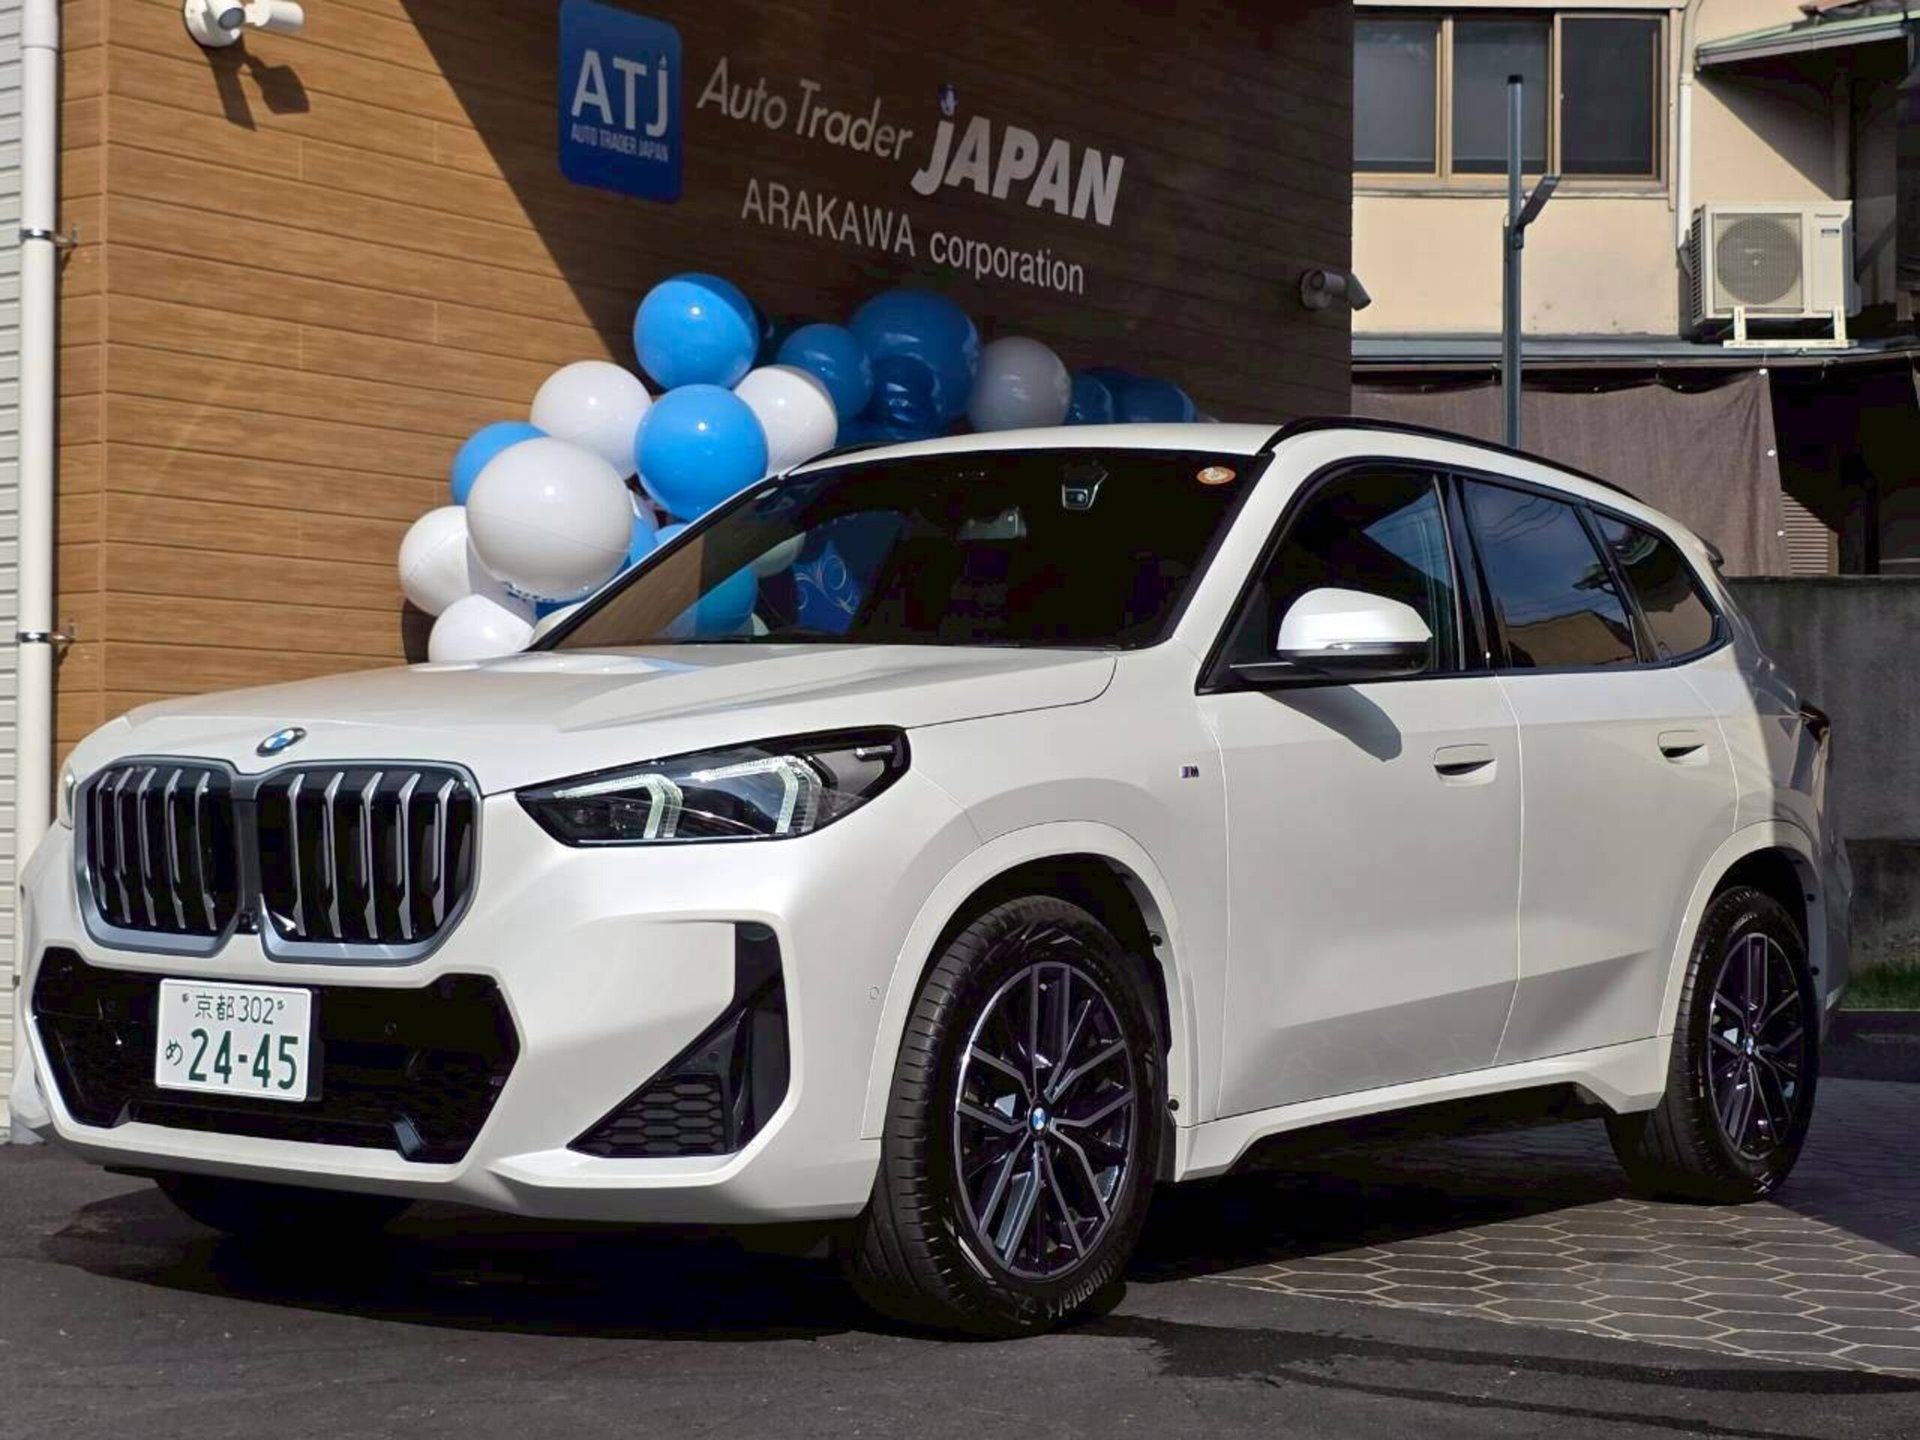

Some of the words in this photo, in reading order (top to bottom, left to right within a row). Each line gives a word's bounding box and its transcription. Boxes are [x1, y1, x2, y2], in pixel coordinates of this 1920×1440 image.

[571, 122, 598, 147] AUTO
[599, 129, 638, 155] TRADER
[638, 140, 669, 163] JAPAN
[696, 56, 788, 130] Auto
[795, 78, 914, 160] Trader
[741, 177, 916, 257] ARAKAWA
[929, 230, 1084, 295] corporation
[165, 1039, 184, 1066] め
[188, 1027, 299, 1091] 24-45
